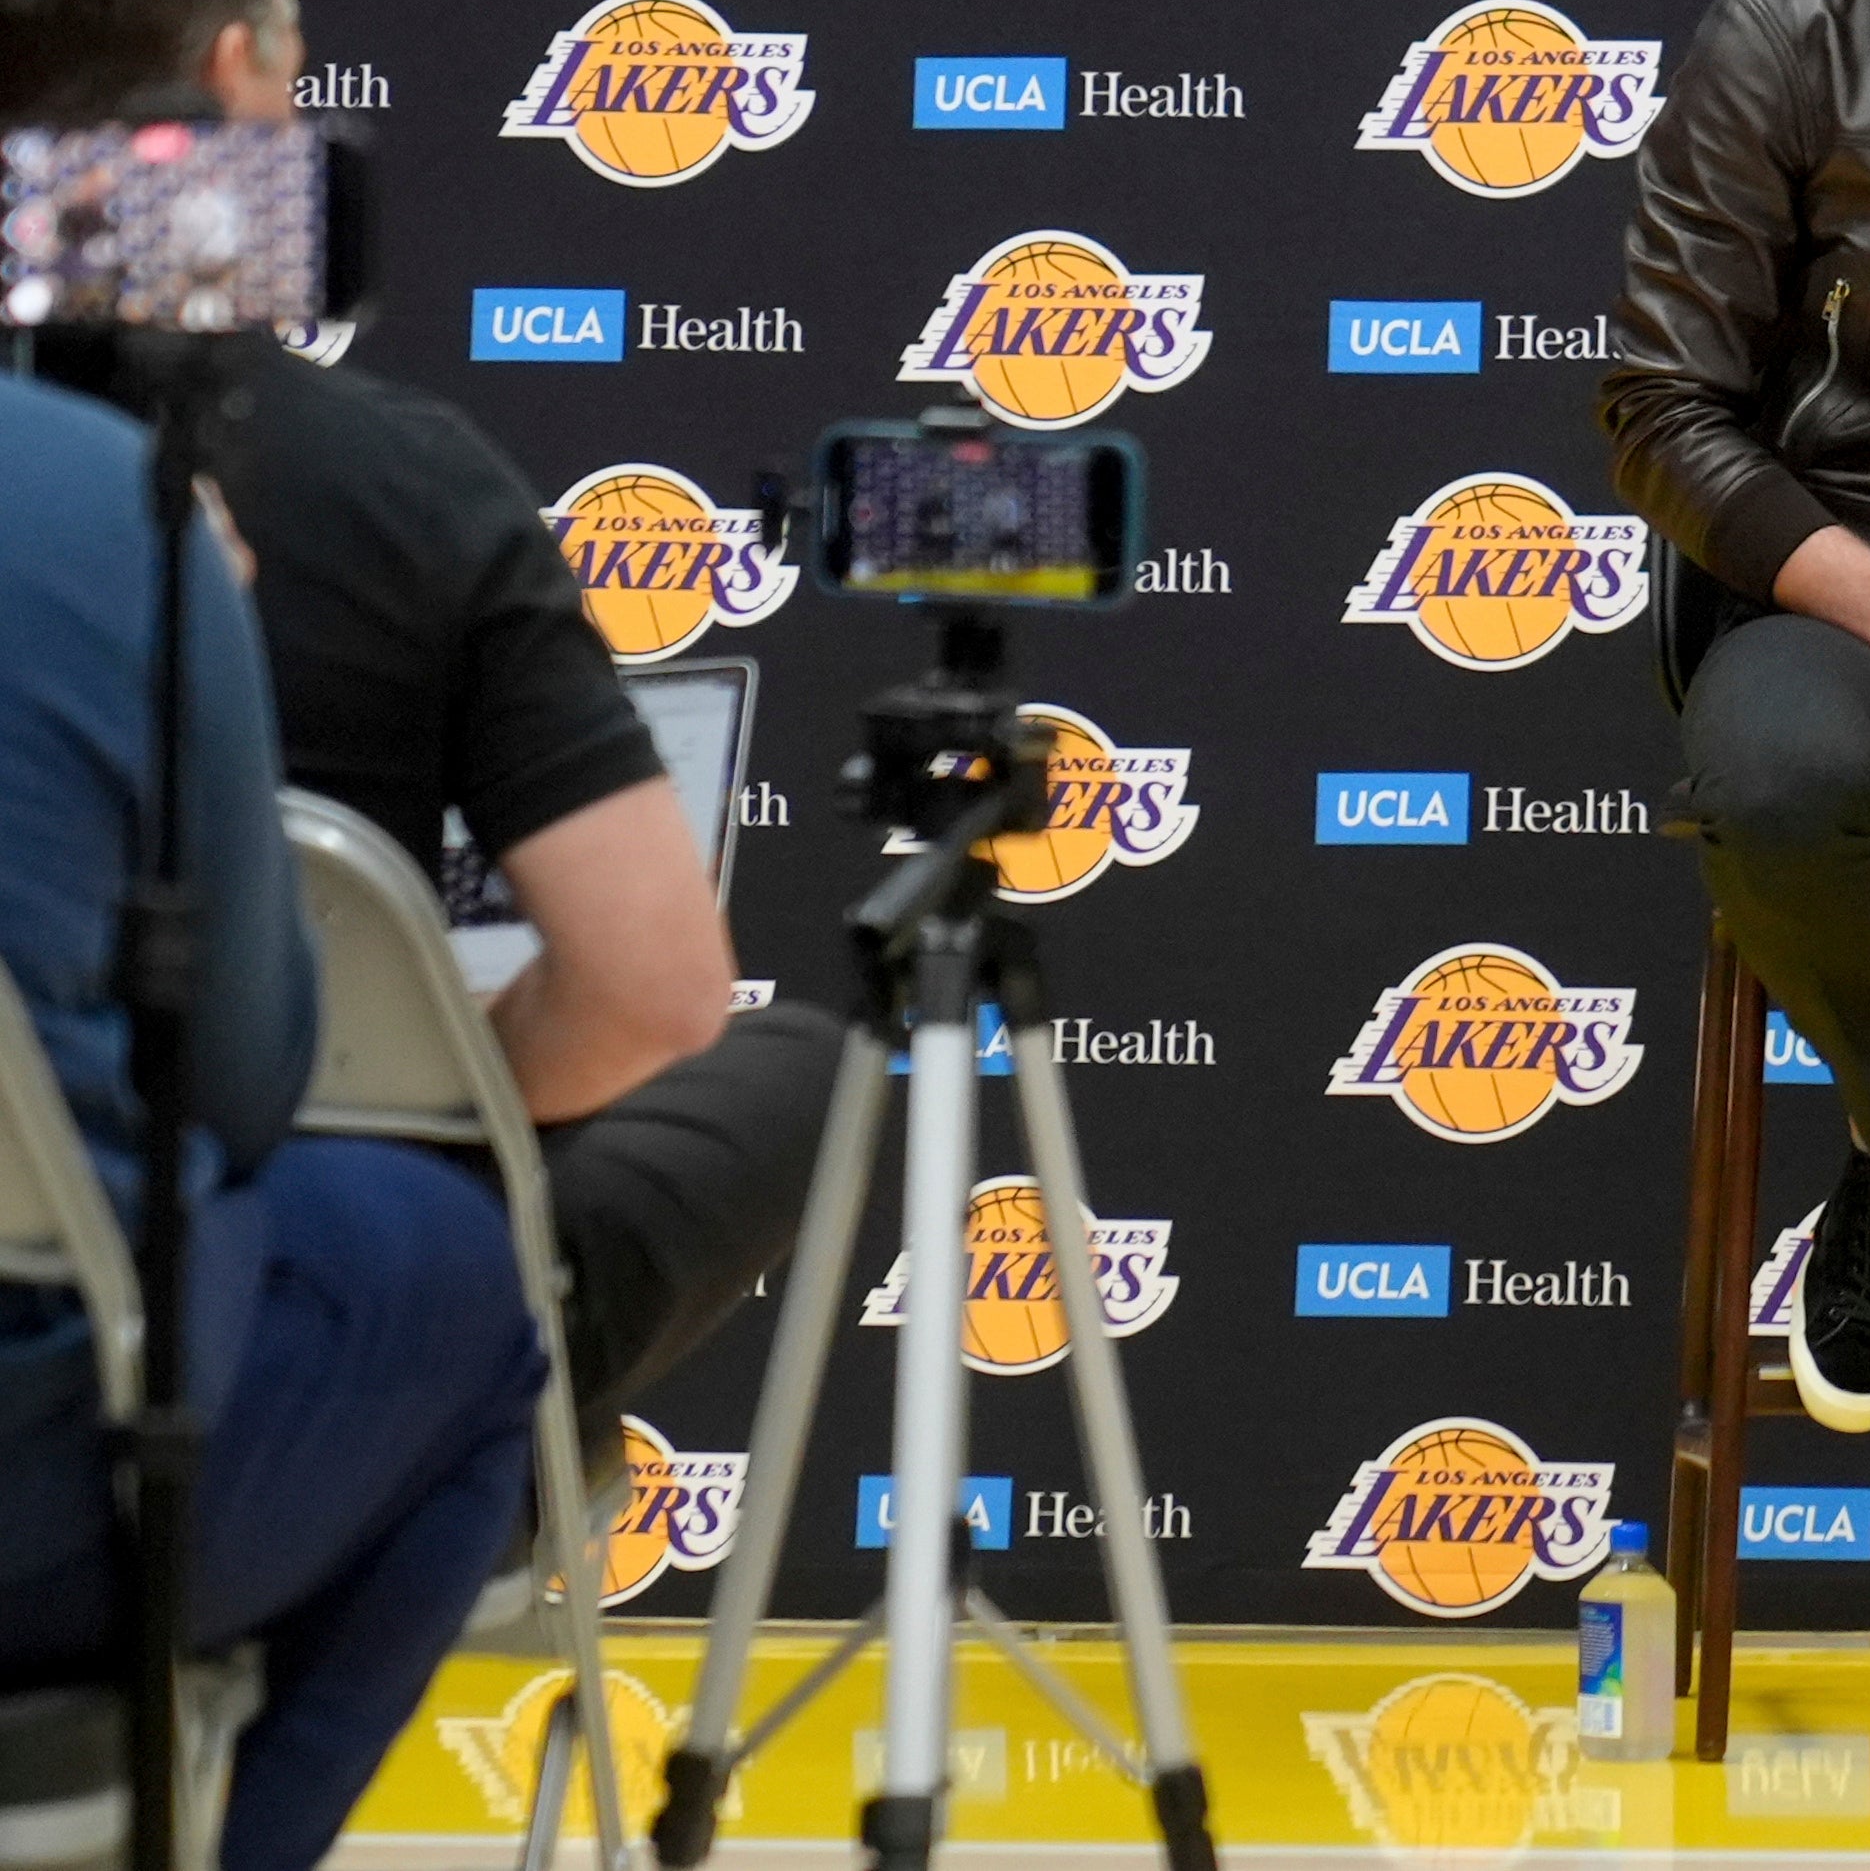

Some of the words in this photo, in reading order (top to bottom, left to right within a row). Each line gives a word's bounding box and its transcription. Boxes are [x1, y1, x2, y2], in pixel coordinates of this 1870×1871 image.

[609, 38, 661, 57] LOS
[665, 39, 794, 60] ANGELES
[524, 38, 795, 139] LAKERS
[935, 74, 1046, 112] UCLA
[1080, 72, 1246, 117] Health
[1380, 50, 1650, 146] LAKERS
[493, 305, 605, 345] UCLA
[638, 305, 805, 352] Health
[921, 282, 1192, 380] LAKERS
[1350, 318, 1462, 356] UCLA
[1367, 524, 1637, 621] LAKERS
[1337, 789, 1449, 828] UCLA
[1484, 788, 1650, 833] Health
[1437, 994, 1489, 1013] LOS
[1492, 995, 1623, 1014] ANGELES
[1050, 1020, 1216, 1064] Health
[1351, 995, 1624, 1093] LAKERS
[1317, 1261, 1430, 1300] UCLA
[1464, 1260, 1632, 1306] Health
[1327, 1468, 1602, 1568] LAKERS
[1743, 1504, 1857, 1543] UCLA
